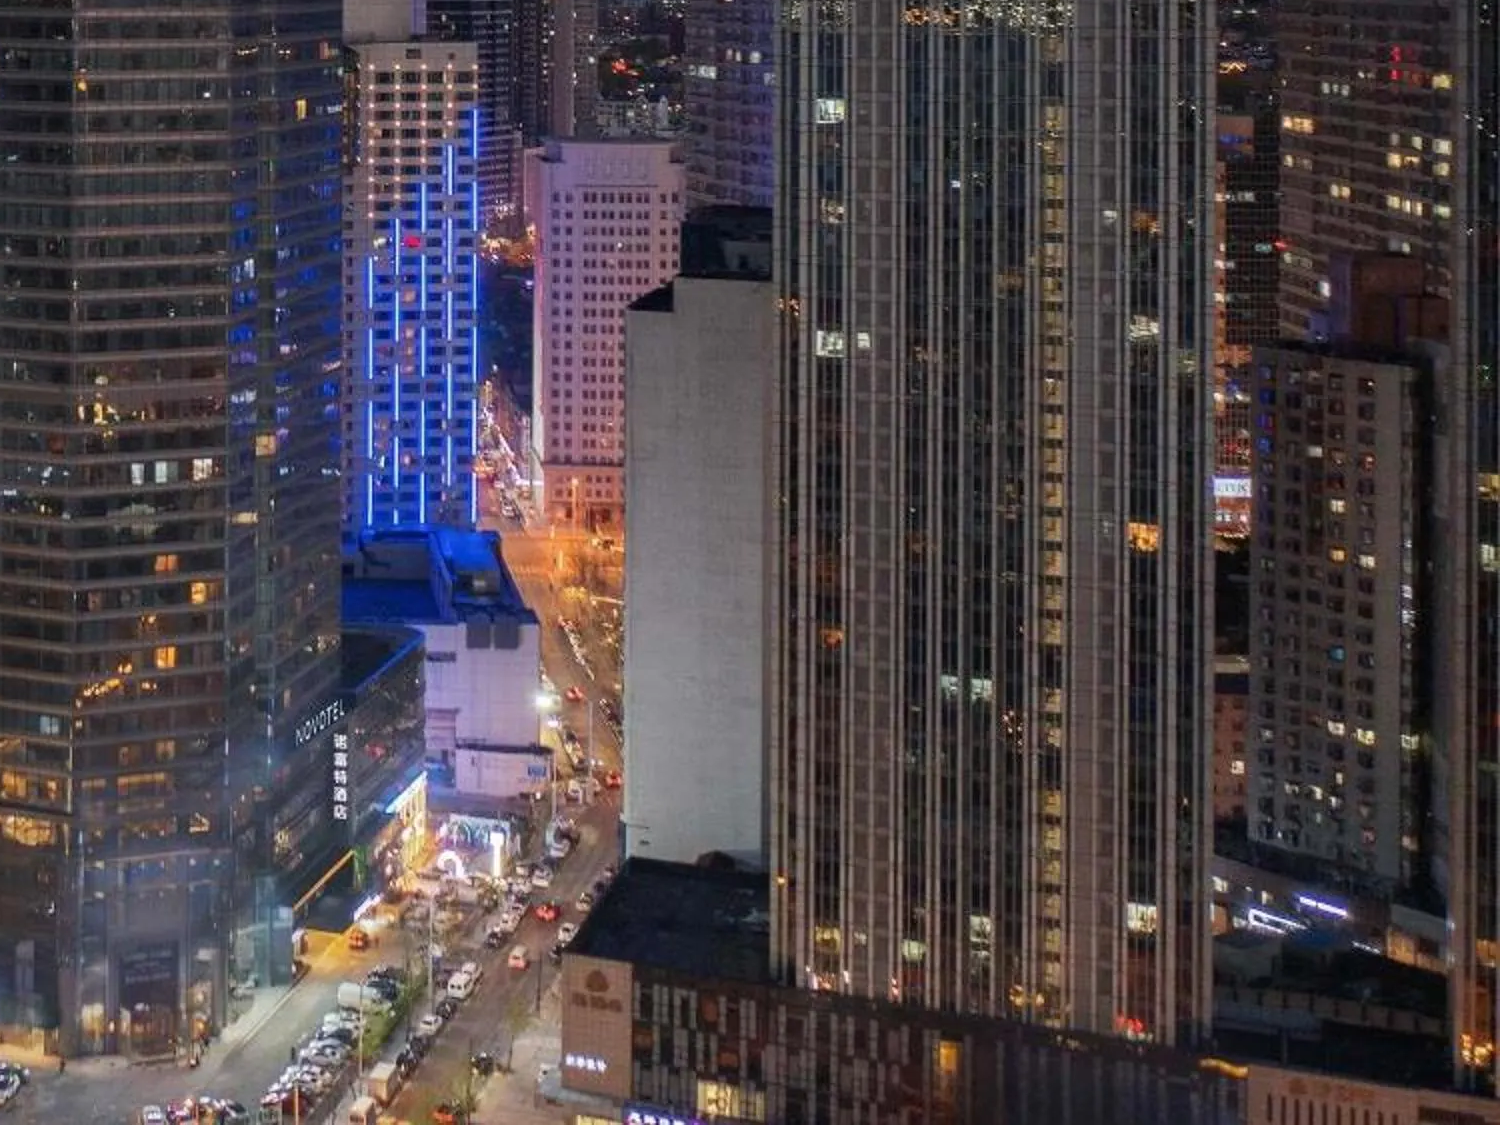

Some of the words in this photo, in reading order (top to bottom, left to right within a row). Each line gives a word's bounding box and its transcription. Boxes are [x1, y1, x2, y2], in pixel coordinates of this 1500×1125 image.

[295, 699, 345, 746] NOVOTEL
[333, 733, 348, 820] 诺富特酒店
